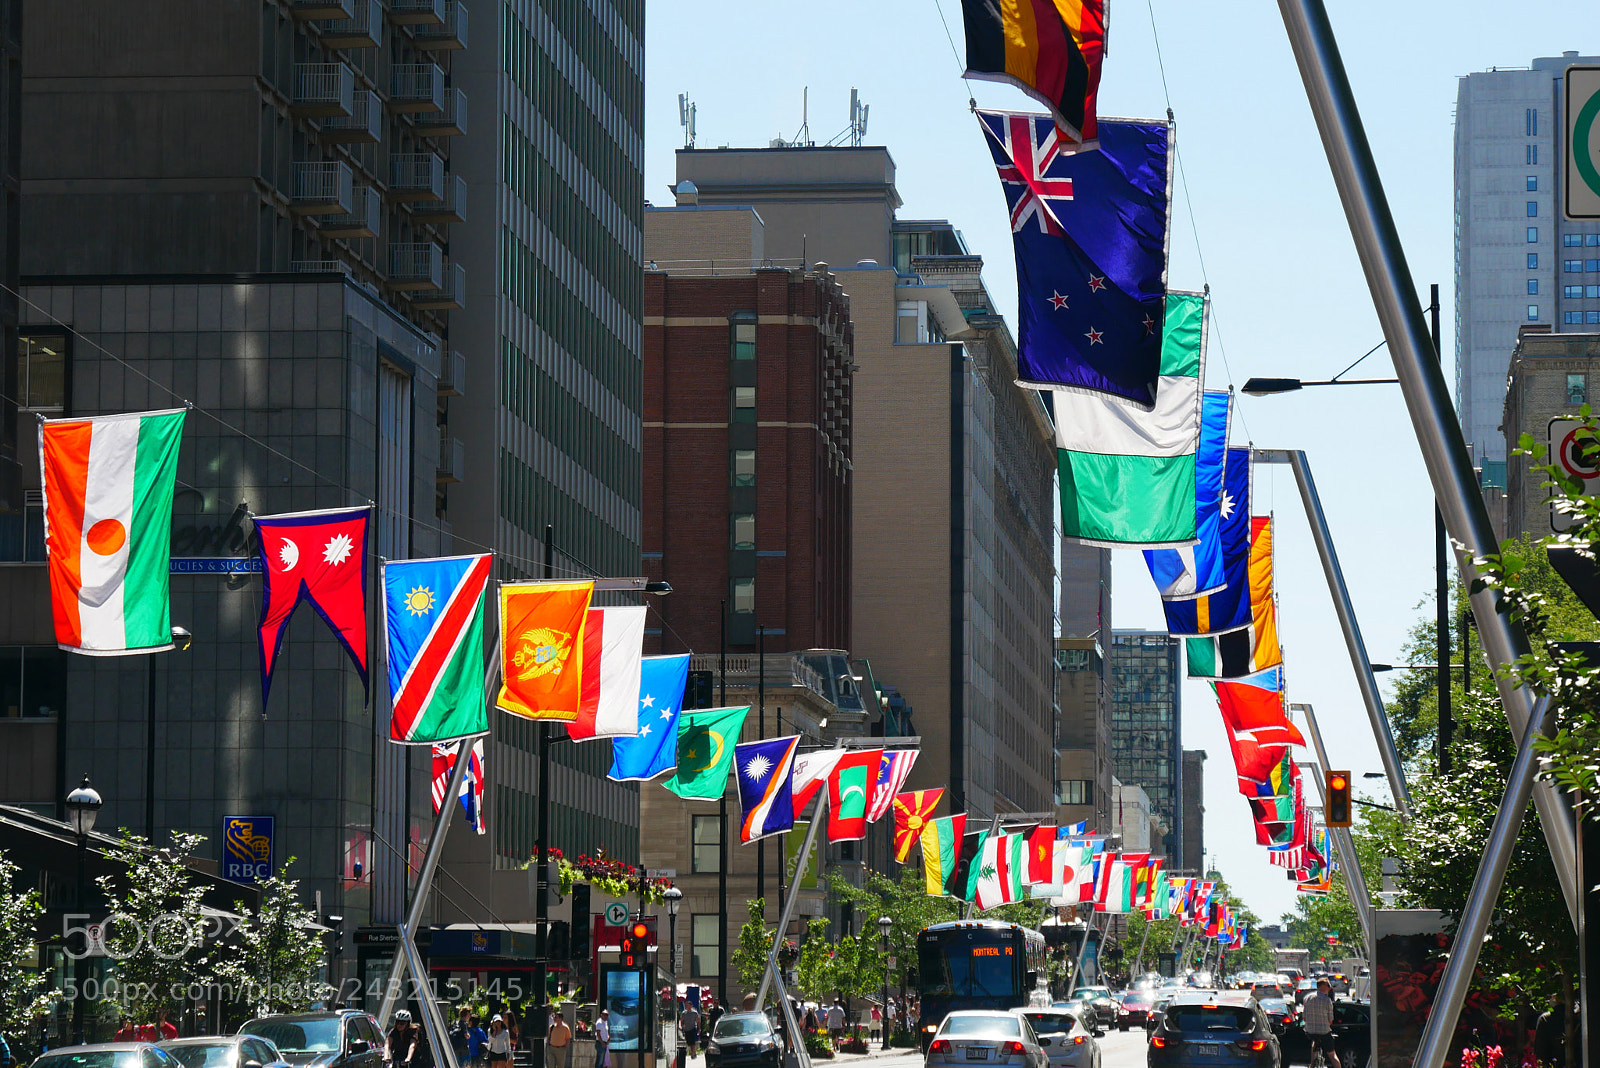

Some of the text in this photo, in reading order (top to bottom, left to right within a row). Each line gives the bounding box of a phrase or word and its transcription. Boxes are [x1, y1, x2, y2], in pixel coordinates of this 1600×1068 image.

[207, 561, 216, 571] &
[228, 863, 268, 878] RBC
[368, 934, 378, 942] Rue
[973, 947, 1000, 957] MONTREAL
